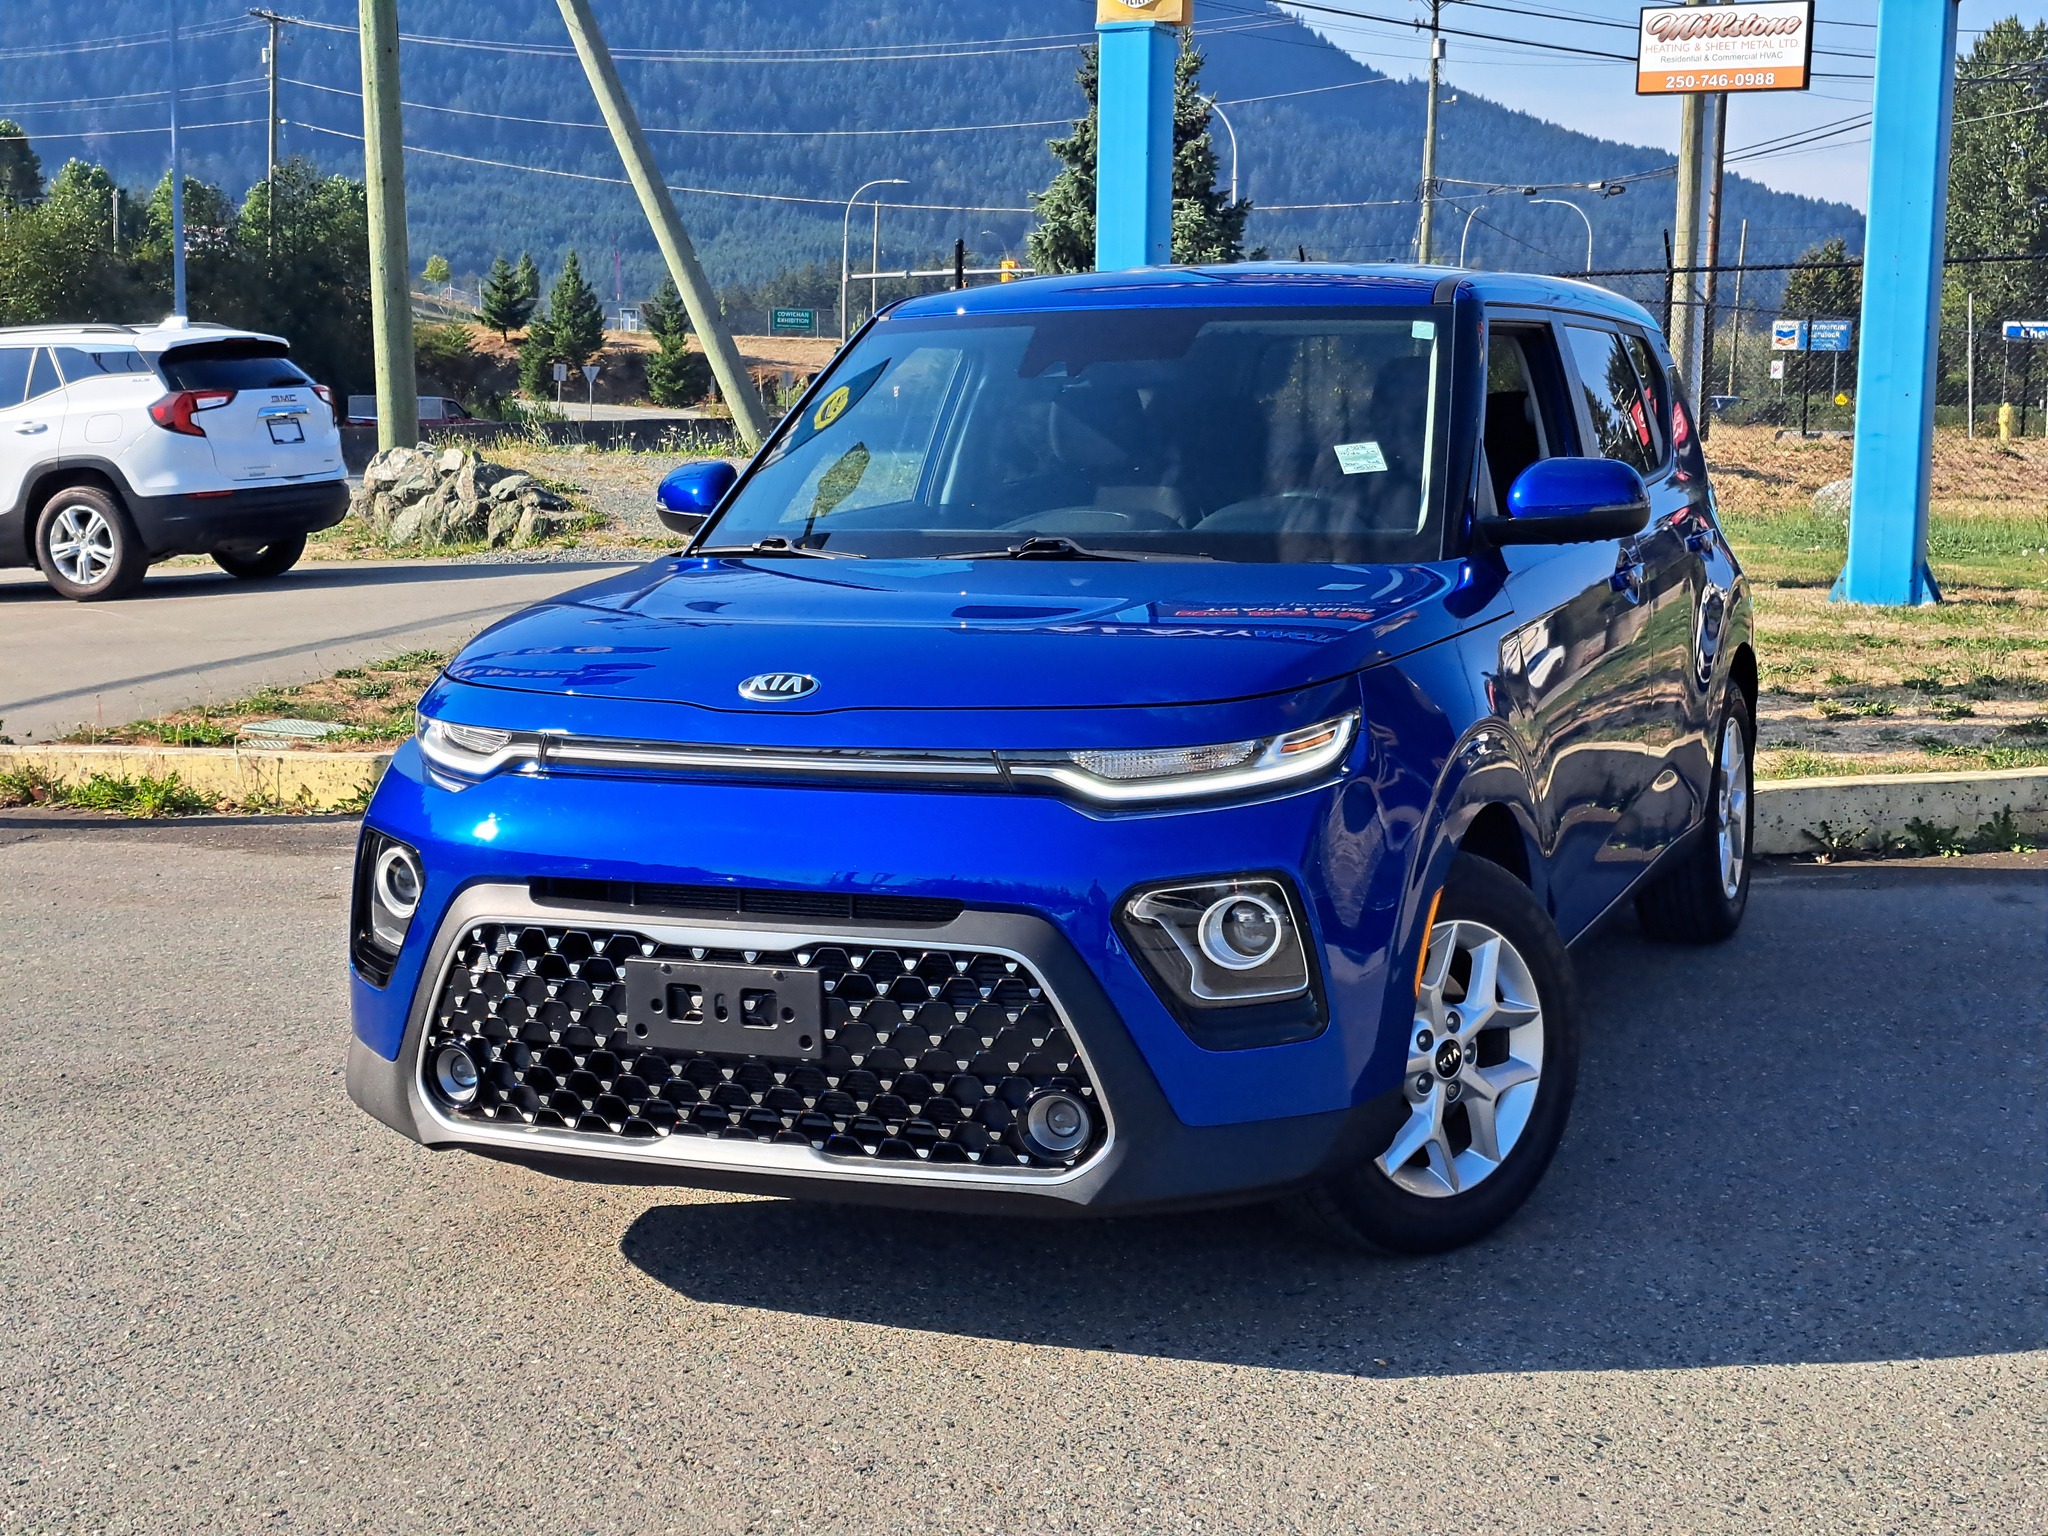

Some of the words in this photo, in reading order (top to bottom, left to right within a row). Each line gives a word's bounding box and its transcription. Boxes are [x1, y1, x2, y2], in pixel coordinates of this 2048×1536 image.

[1646, 12, 1802, 43] Millstone
[1645, 43, 1690, 54] HEATING
[1694, 42, 1702, 51] &
[1705, 41, 1737, 51] SHEET
[1741, 40, 1774, 50] METAL
[1779, 39, 1800, 48] LTD.
[1660, 55, 1702, 63] Residential
[1712, 53, 1757, 61] Commercial
[1759, 51, 1783, 60] HVAC
[1665, 73, 1775, 88] 250-746-0988
[2021, 327, 2048, 339] Che
[271, 394, 297, 403] GMC
[749, 675, 802, 692] KIA
[1439, 1048, 1460, 1071] KIA
